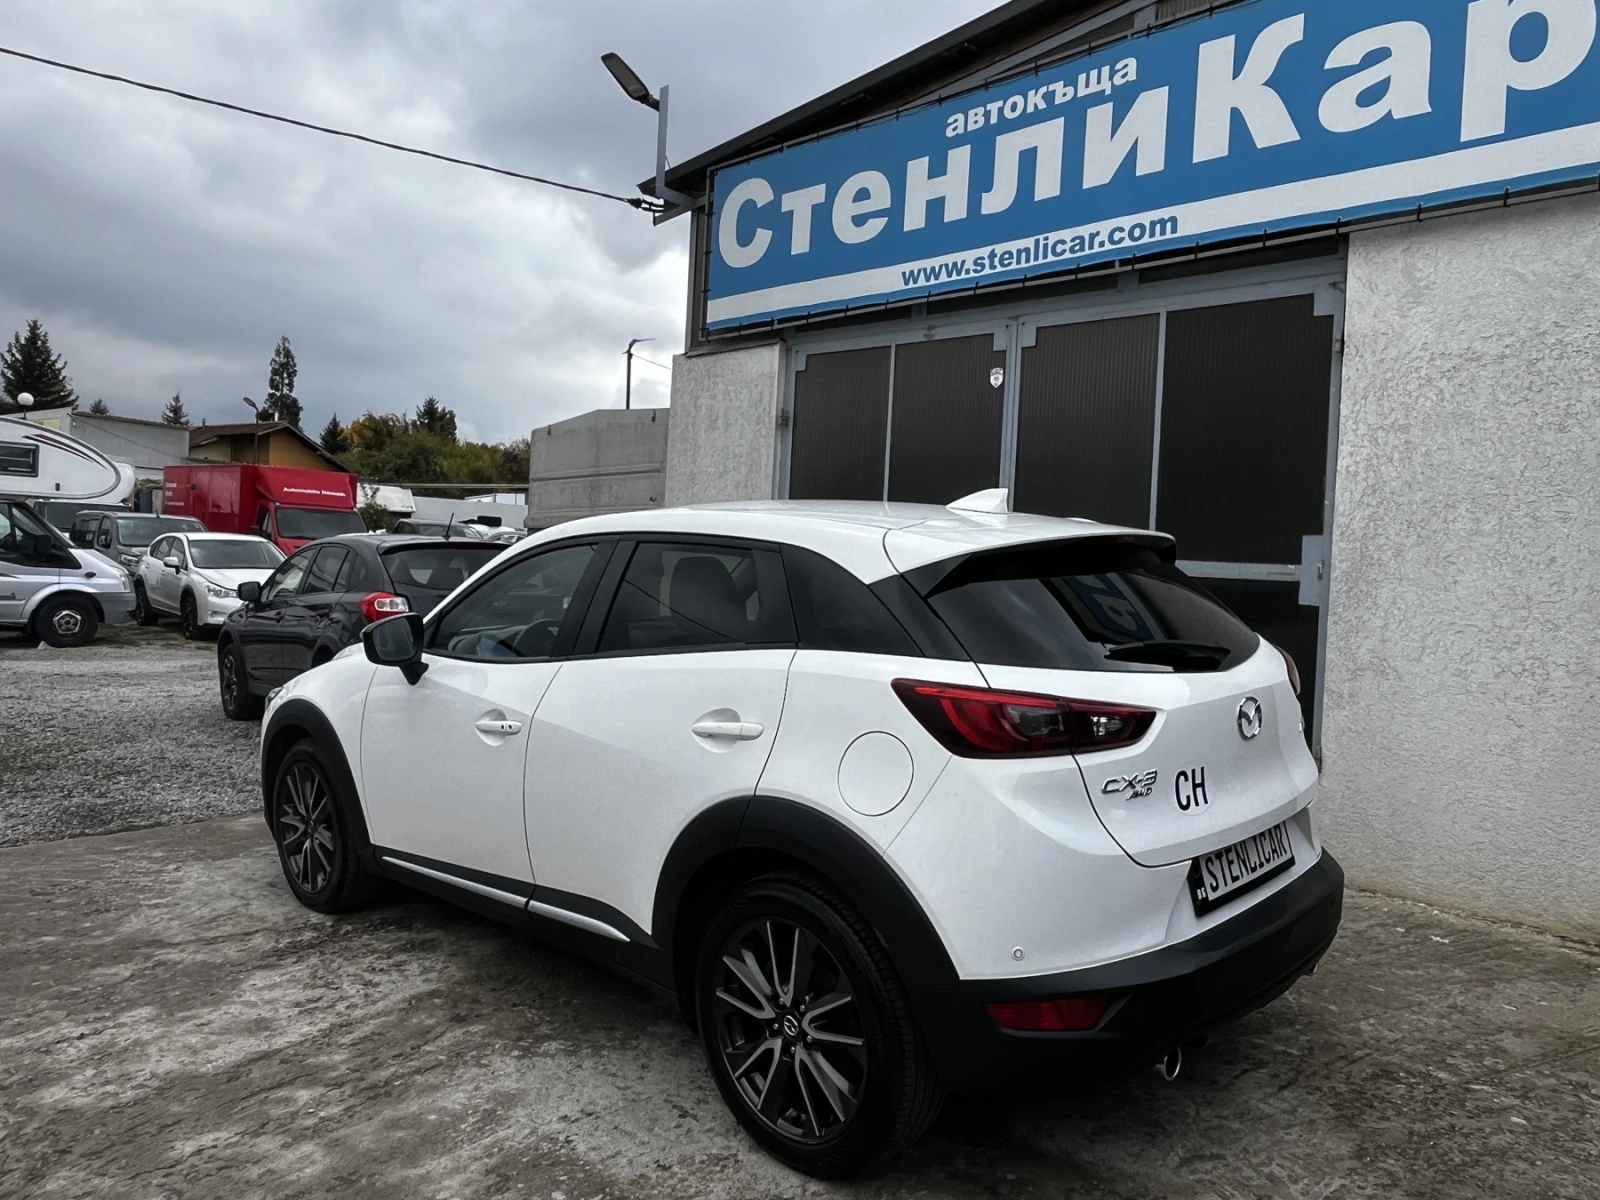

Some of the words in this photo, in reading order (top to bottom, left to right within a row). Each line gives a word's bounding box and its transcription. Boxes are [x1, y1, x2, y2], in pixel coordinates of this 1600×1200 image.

[945, 56, 1138, 139] автокъща
[901, 214, 1178, 287] www.stenlicar.com
[1101, 769, 1157, 795] CX-3
[1174, 766, 1208, 811] CH
